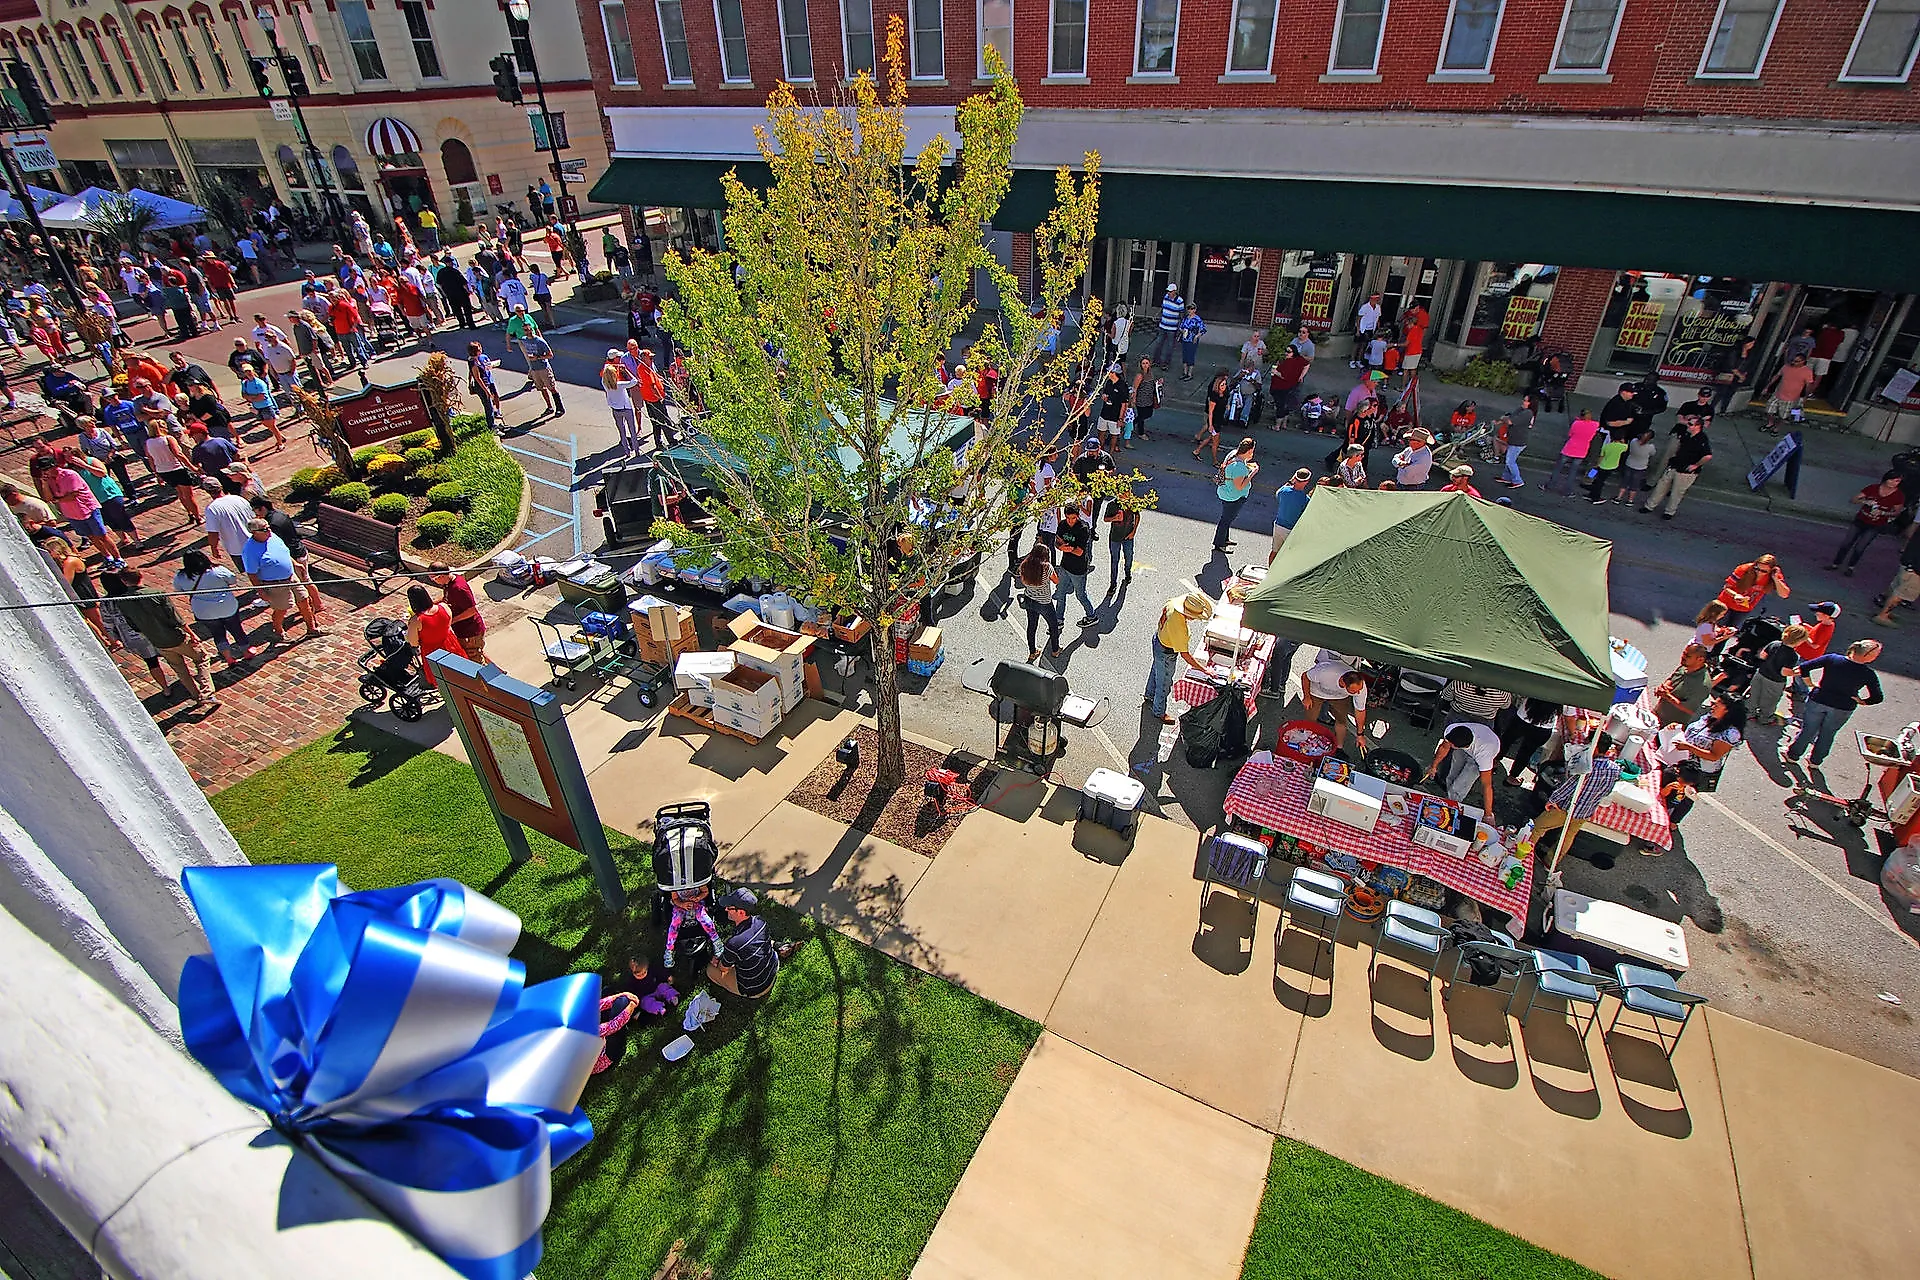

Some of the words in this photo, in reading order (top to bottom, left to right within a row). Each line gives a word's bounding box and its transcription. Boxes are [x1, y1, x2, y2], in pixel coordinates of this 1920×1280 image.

[19, 149, 56, 168] PARKING
[566, 199, 575, 212] P
[1307, 279, 1331, 292] STORE
[1304, 291, 1330, 306] CLOSING
[1511, 297, 1540, 311] STORE
[1302, 304, 1328, 319] SALE
[1630, 302, 1662, 316] STORE
[1505, 309, 1537, 325] CLOSING
[1624, 315, 1658, 332] CLOSING
[1503, 323, 1533, 340] SALE
[1618, 330, 1652, 348] SALE
[348, 415, 377, 426] CHAMBER
[386, 404, 419, 416] COMMERCE
[359, 408, 384, 417] NEWBERRY
[384, 402, 404, 411] COUNTY
[365, 426, 389, 435] VISITOR
[389, 420, 413, 429] CENTER
